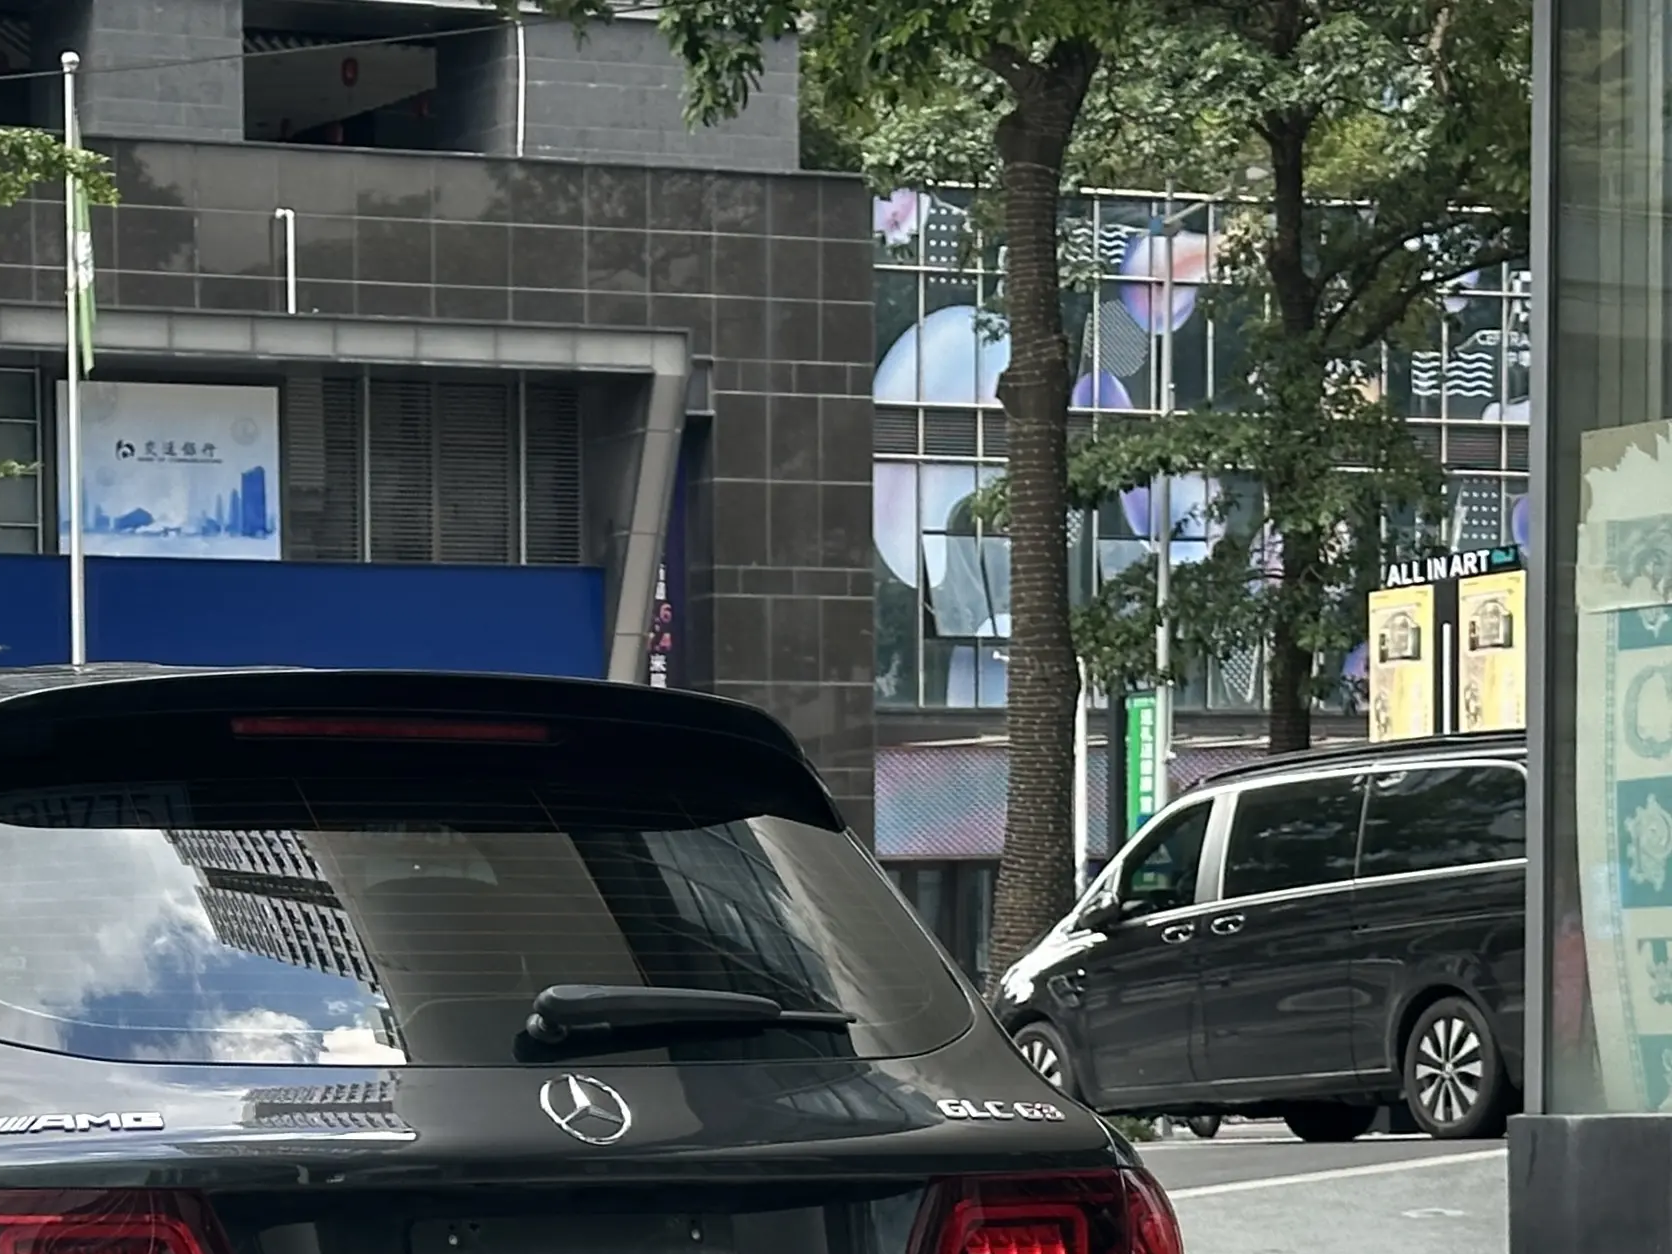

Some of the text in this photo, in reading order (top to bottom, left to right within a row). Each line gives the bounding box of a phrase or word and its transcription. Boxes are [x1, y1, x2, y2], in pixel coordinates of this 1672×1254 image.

[1387, 560, 1426, 587] ALL
[1427, 556, 1447, 581] IN
[1449, 549, 1490, 578] ART
[936, 1099, 1066, 1122] GLC 63
[29, 1112, 165, 1133] AMG
